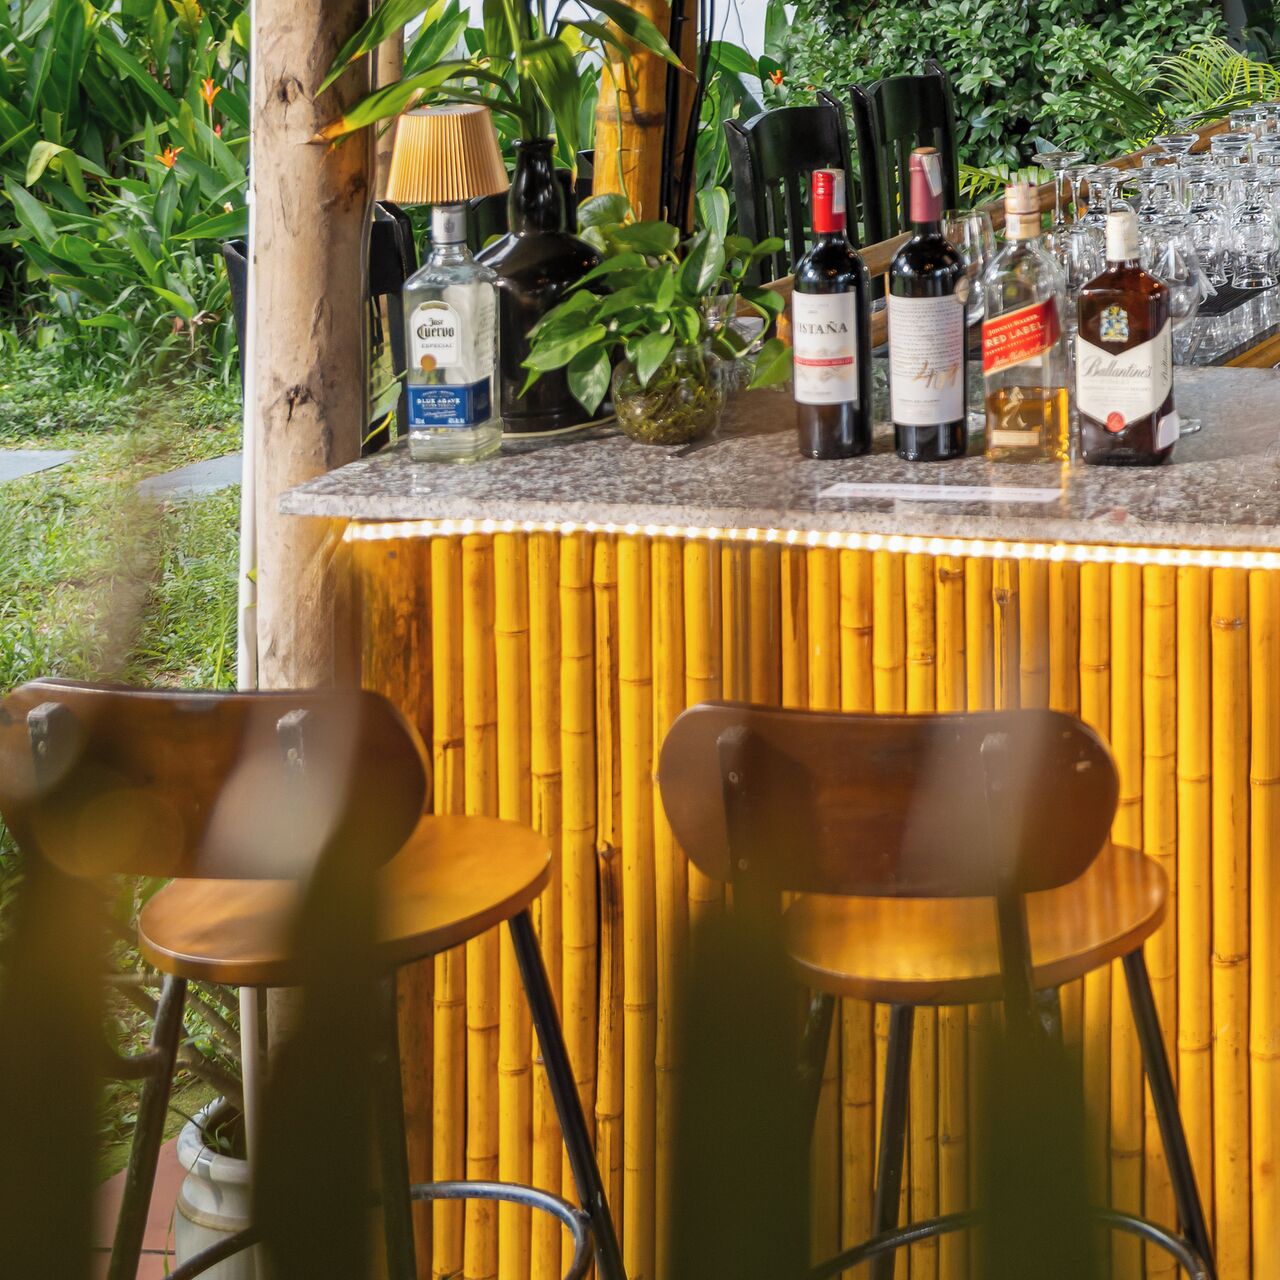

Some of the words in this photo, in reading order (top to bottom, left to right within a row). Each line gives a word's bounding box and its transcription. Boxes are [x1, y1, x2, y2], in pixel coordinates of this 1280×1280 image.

[416, 323, 455, 340] Cuervo
[985, 334, 1007, 348] RED
[1008, 322, 1044, 340] LABEL
[1083, 355, 1152, 378] Ballantine's
[437, 397, 461, 405] AGAVE
